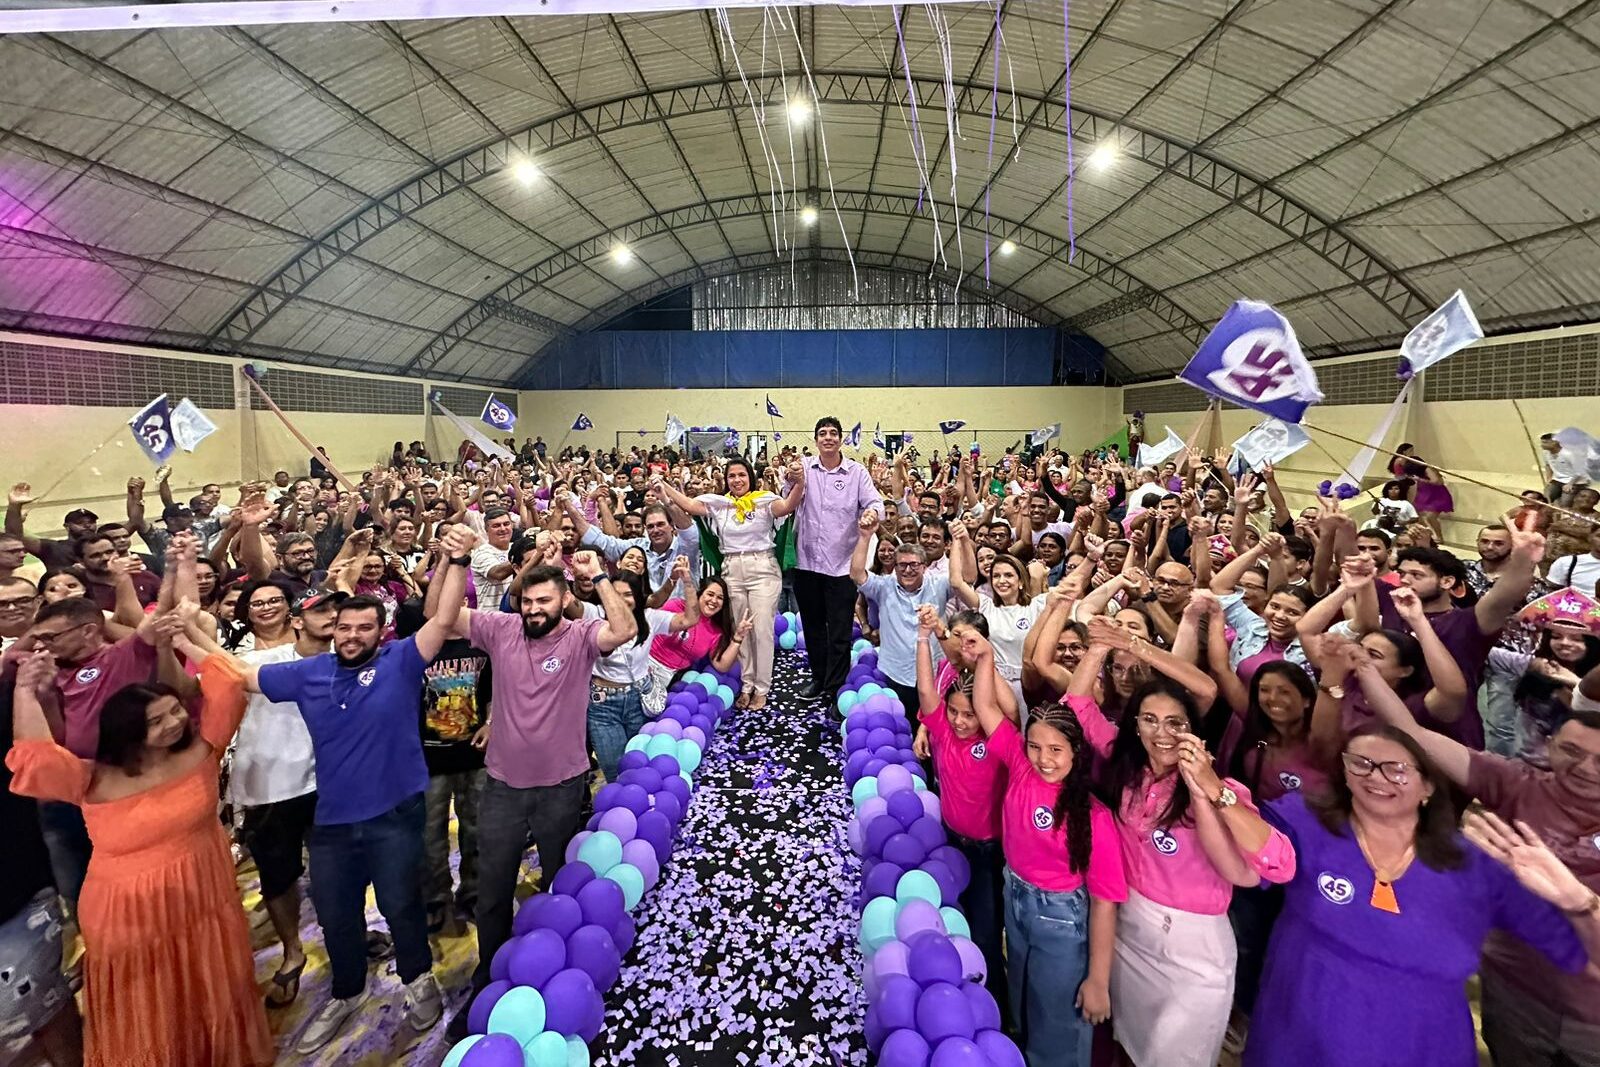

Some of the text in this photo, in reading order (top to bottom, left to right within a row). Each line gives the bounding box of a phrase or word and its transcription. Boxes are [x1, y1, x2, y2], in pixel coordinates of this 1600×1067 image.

[1223, 341, 1294, 399] 45
[490, 407, 505, 420] 45
[142, 424, 162, 446] 45
[545, 661, 557, 669] 45
[80, 670, 95, 680] 45
[361, 671, 373, 681] 45
[973, 746, 985, 756] 45
[1283, 776, 1297, 788] 45
[1036, 812, 1048, 825] 45
[1155, 836, 1174, 851] 45
[1324, 880, 1347, 897] 45
